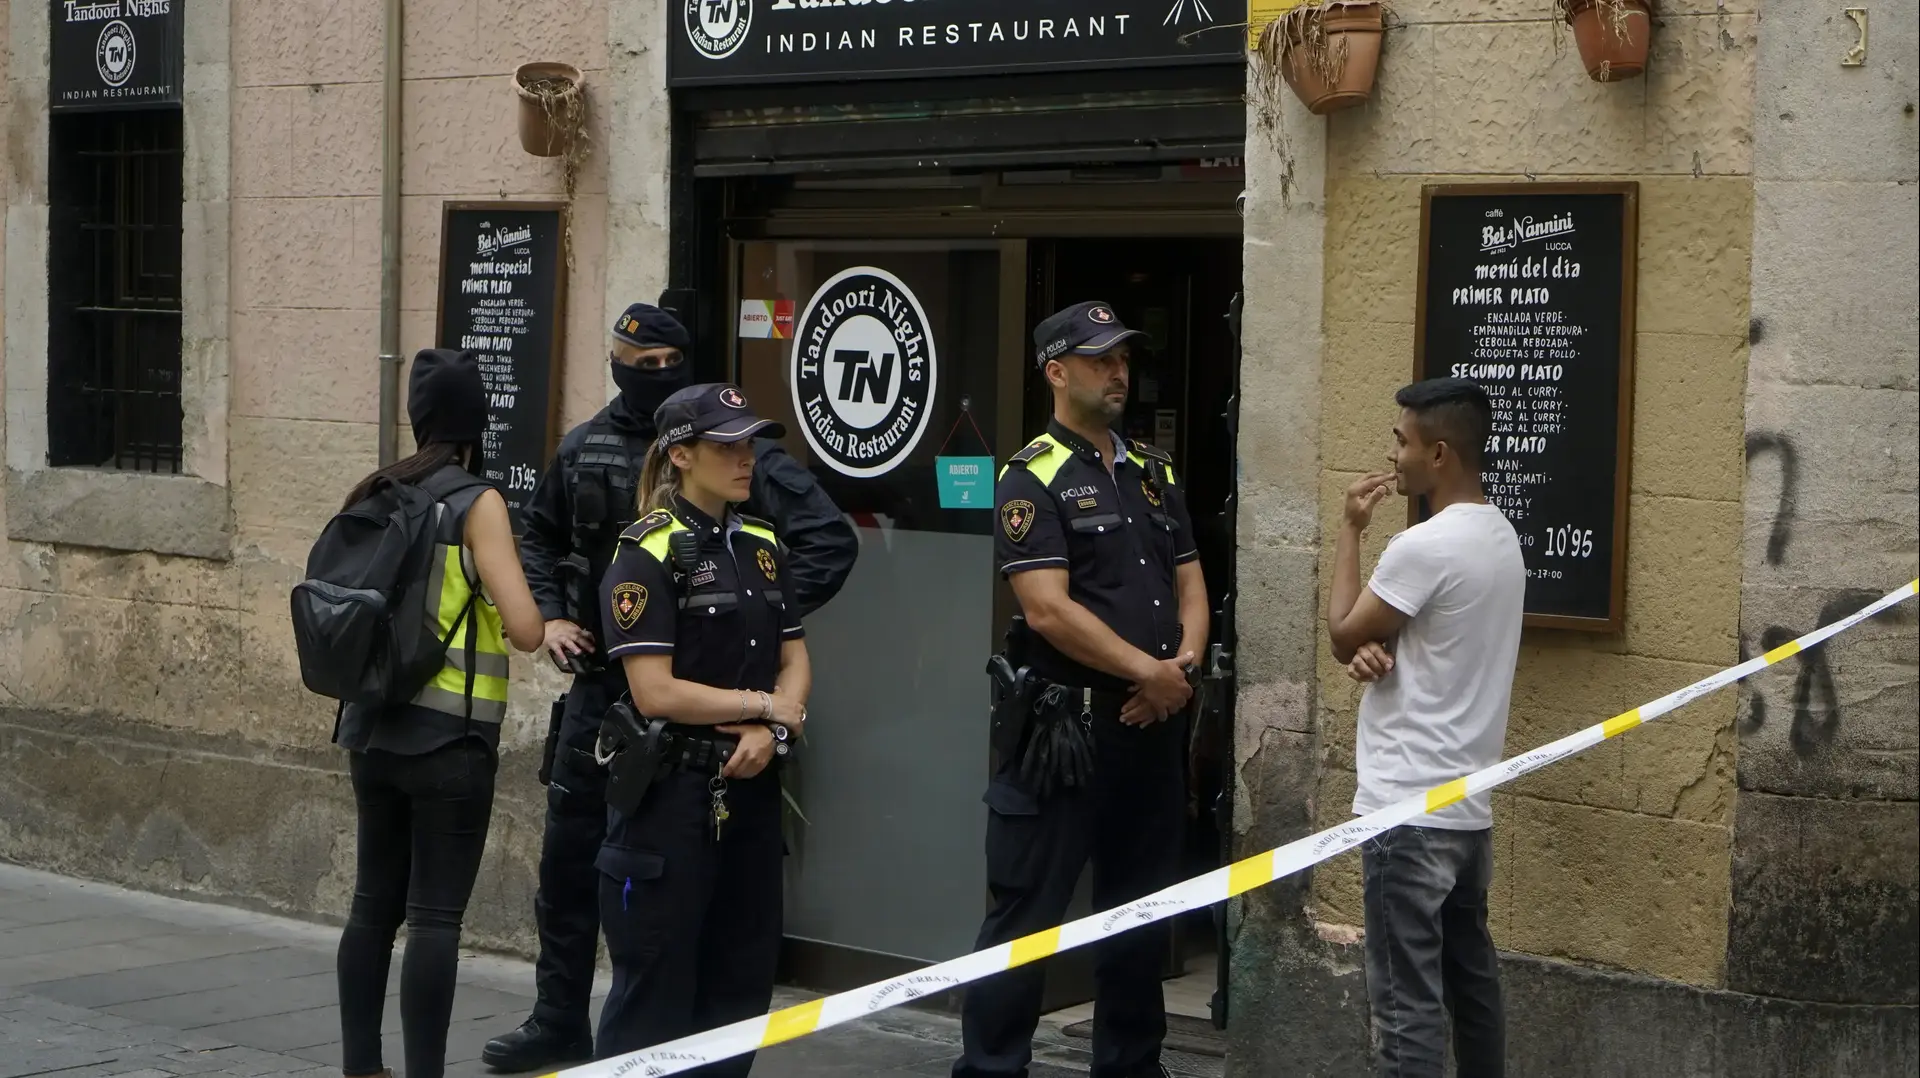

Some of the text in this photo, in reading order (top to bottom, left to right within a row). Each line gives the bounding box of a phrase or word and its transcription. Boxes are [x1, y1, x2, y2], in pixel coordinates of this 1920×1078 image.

[64, 0, 170, 22] Tandoori Nights
[692, 17, 747, 51] Indian Restaurant
[766, 15, 1130, 53] INDIAN RESTAURANT
[108, 46, 124, 62] TN
[63, 85, 171, 100] INDIAN RESTAURANT
[1481, 212, 1574, 248] Bei & Nannini
[493, 224, 531, 252] Nannini
[1545, 243, 1572, 251] LUCCA
[470, 256, 533, 279] menú especial
[1475, 257, 1518, 280] menú
[1522, 256, 1548, 279] del
[490, 280, 513, 294] PLATO
[480, 299, 524, 307] ENSALADA VERDE
[1510, 288, 1550, 306] PLATO
[505, 308, 511, 316] DE
[512, 308, 534, 317] VERDURA
[743, 314, 768, 322] ABIERTO
[1487, 311, 1563, 323] ENSALADA VERDE
[475, 316, 495, 324] CEBOLLA
[473, 325, 502, 333] CROQUETAS
[512, 327, 528, 335] POLLO
[801, 284, 924, 382] Tandoori Nights
[1533, 325, 1542, 335] DE
[1545, 325, 1582, 336] VERDURA
[461, 335, 513, 352] SEGUNDO PLATO
[1479, 337, 1568, 348] CEBOLLA REBOZADA
[478, 354, 494, 363] POLLO
[1474, 349, 1576, 360] CROQUETAS DE POLLO
[833, 349, 895, 405] TN
[1451, 363, 1563, 381] SEGUNDO PLATO
[494, 383, 502, 391] AL
[1512, 386, 1522, 396] AL
[1528, 386, 1558, 397] CURRY
[490, 393, 515, 409] PLATO
[1489, 399, 1562, 411] ERO AL CURRY
[1491, 411, 1561, 423] URAS AL CURRY
[805, 394, 918, 459] Indian Restaurant
[1491, 422, 1561, 434] EjAS AL CURRY
[1506, 436, 1546, 454] PLATO
[483, 451, 497, 459] TRE
[949, 464, 979, 476] ABIERTO
[1496, 459, 1519, 471] NAN
[508, 463, 537, 492] 13'95
[1480, 472, 1500, 483] ROZ
[1492, 484, 1521, 495] ROTE
[1502, 509, 1523, 519] TRE
[1545, 523, 1593, 558] 10'95
[1525, 569, 1563, 579] 0-17:00
[614, 584, 644, 594] BARCELONA
